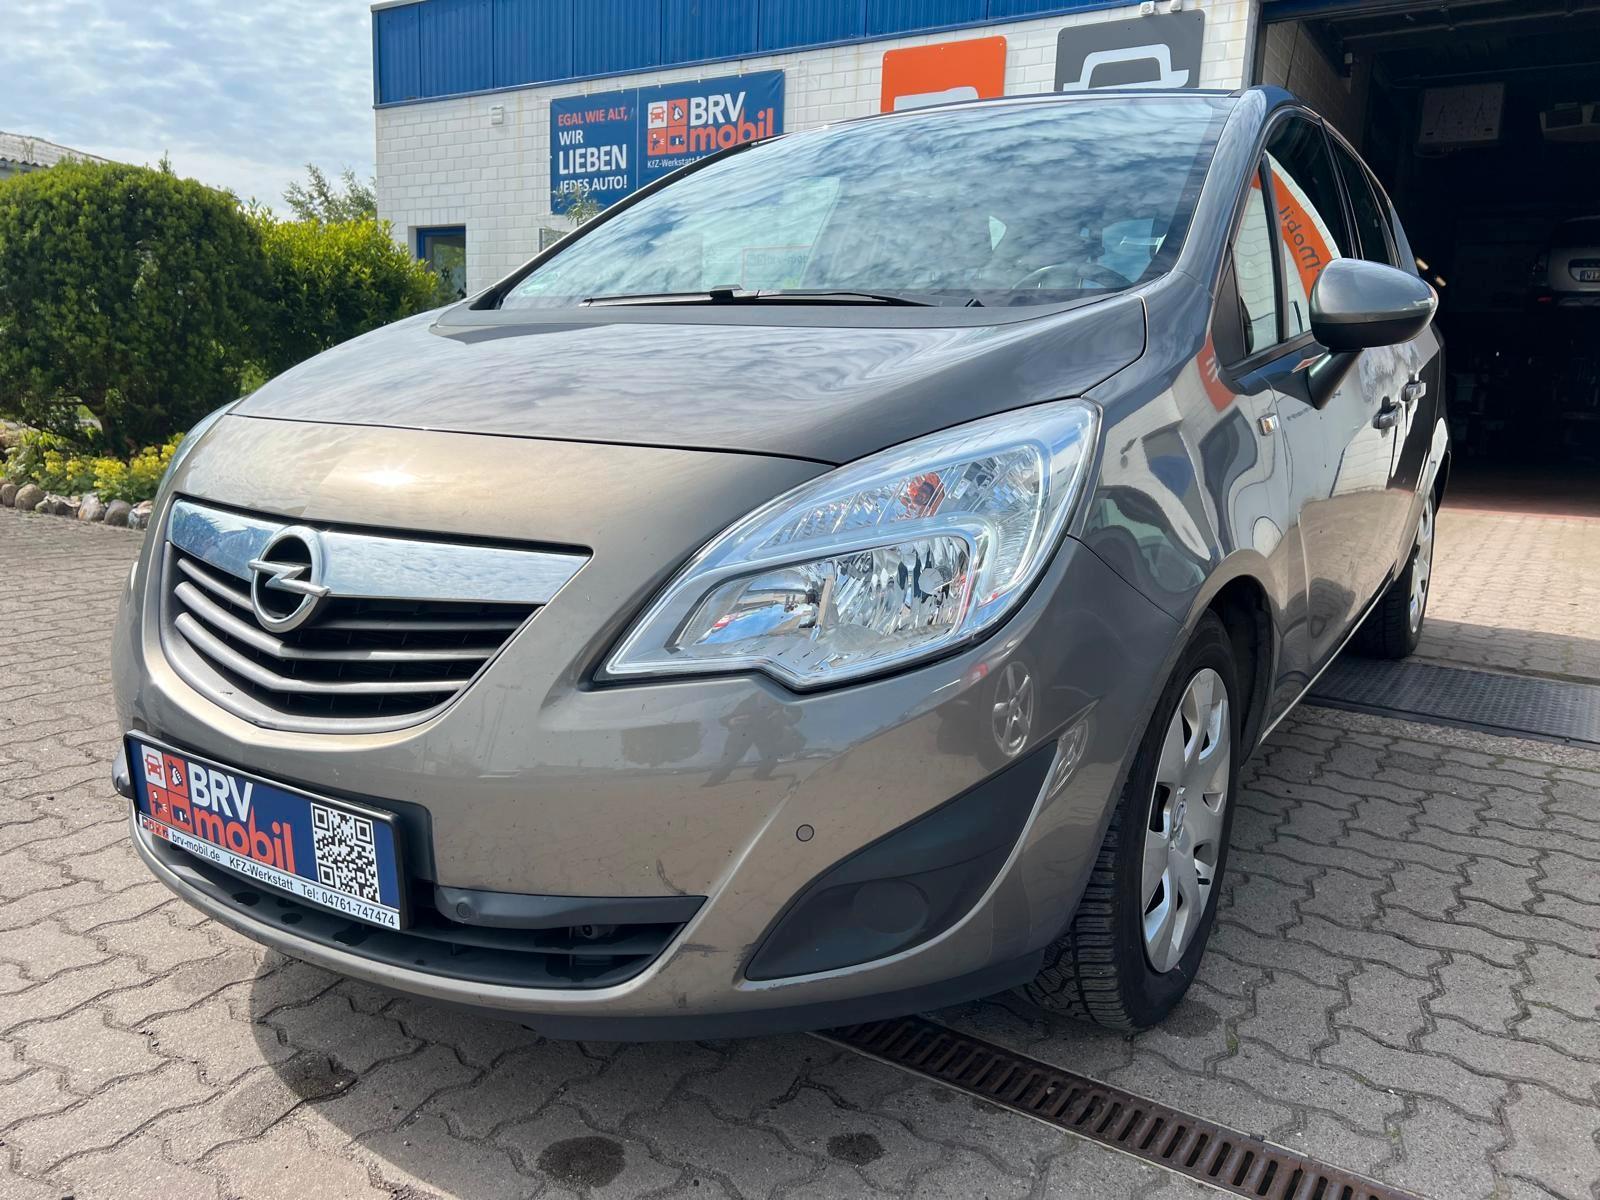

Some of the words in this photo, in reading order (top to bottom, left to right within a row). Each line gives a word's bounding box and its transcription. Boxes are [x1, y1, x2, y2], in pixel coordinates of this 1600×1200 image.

[558, 112, 584, 127] EGAL
[585, 109, 606, 123] WIE
[607, 106, 628, 121] ALT,
[690, 91, 746, 126] BRV
[558, 129, 584, 146] WIR
[689, 107, 774, 152] mobil
[558, 143, 628, 175] LIEBEN
[559, 178, 590, 195] JEDES
[591, 174, 628, 192] AUTO!
[188, 761, 254, 823] BRV
[193, 806, 296, 875] mobil
[171, 831, 221, 863] brv-mobil.de
[229, 855, 295, 892] KFZ-Werkstatt
[301, 883, 320, 901] Tel:
[322, 890, 396, 928] 04761-747474
